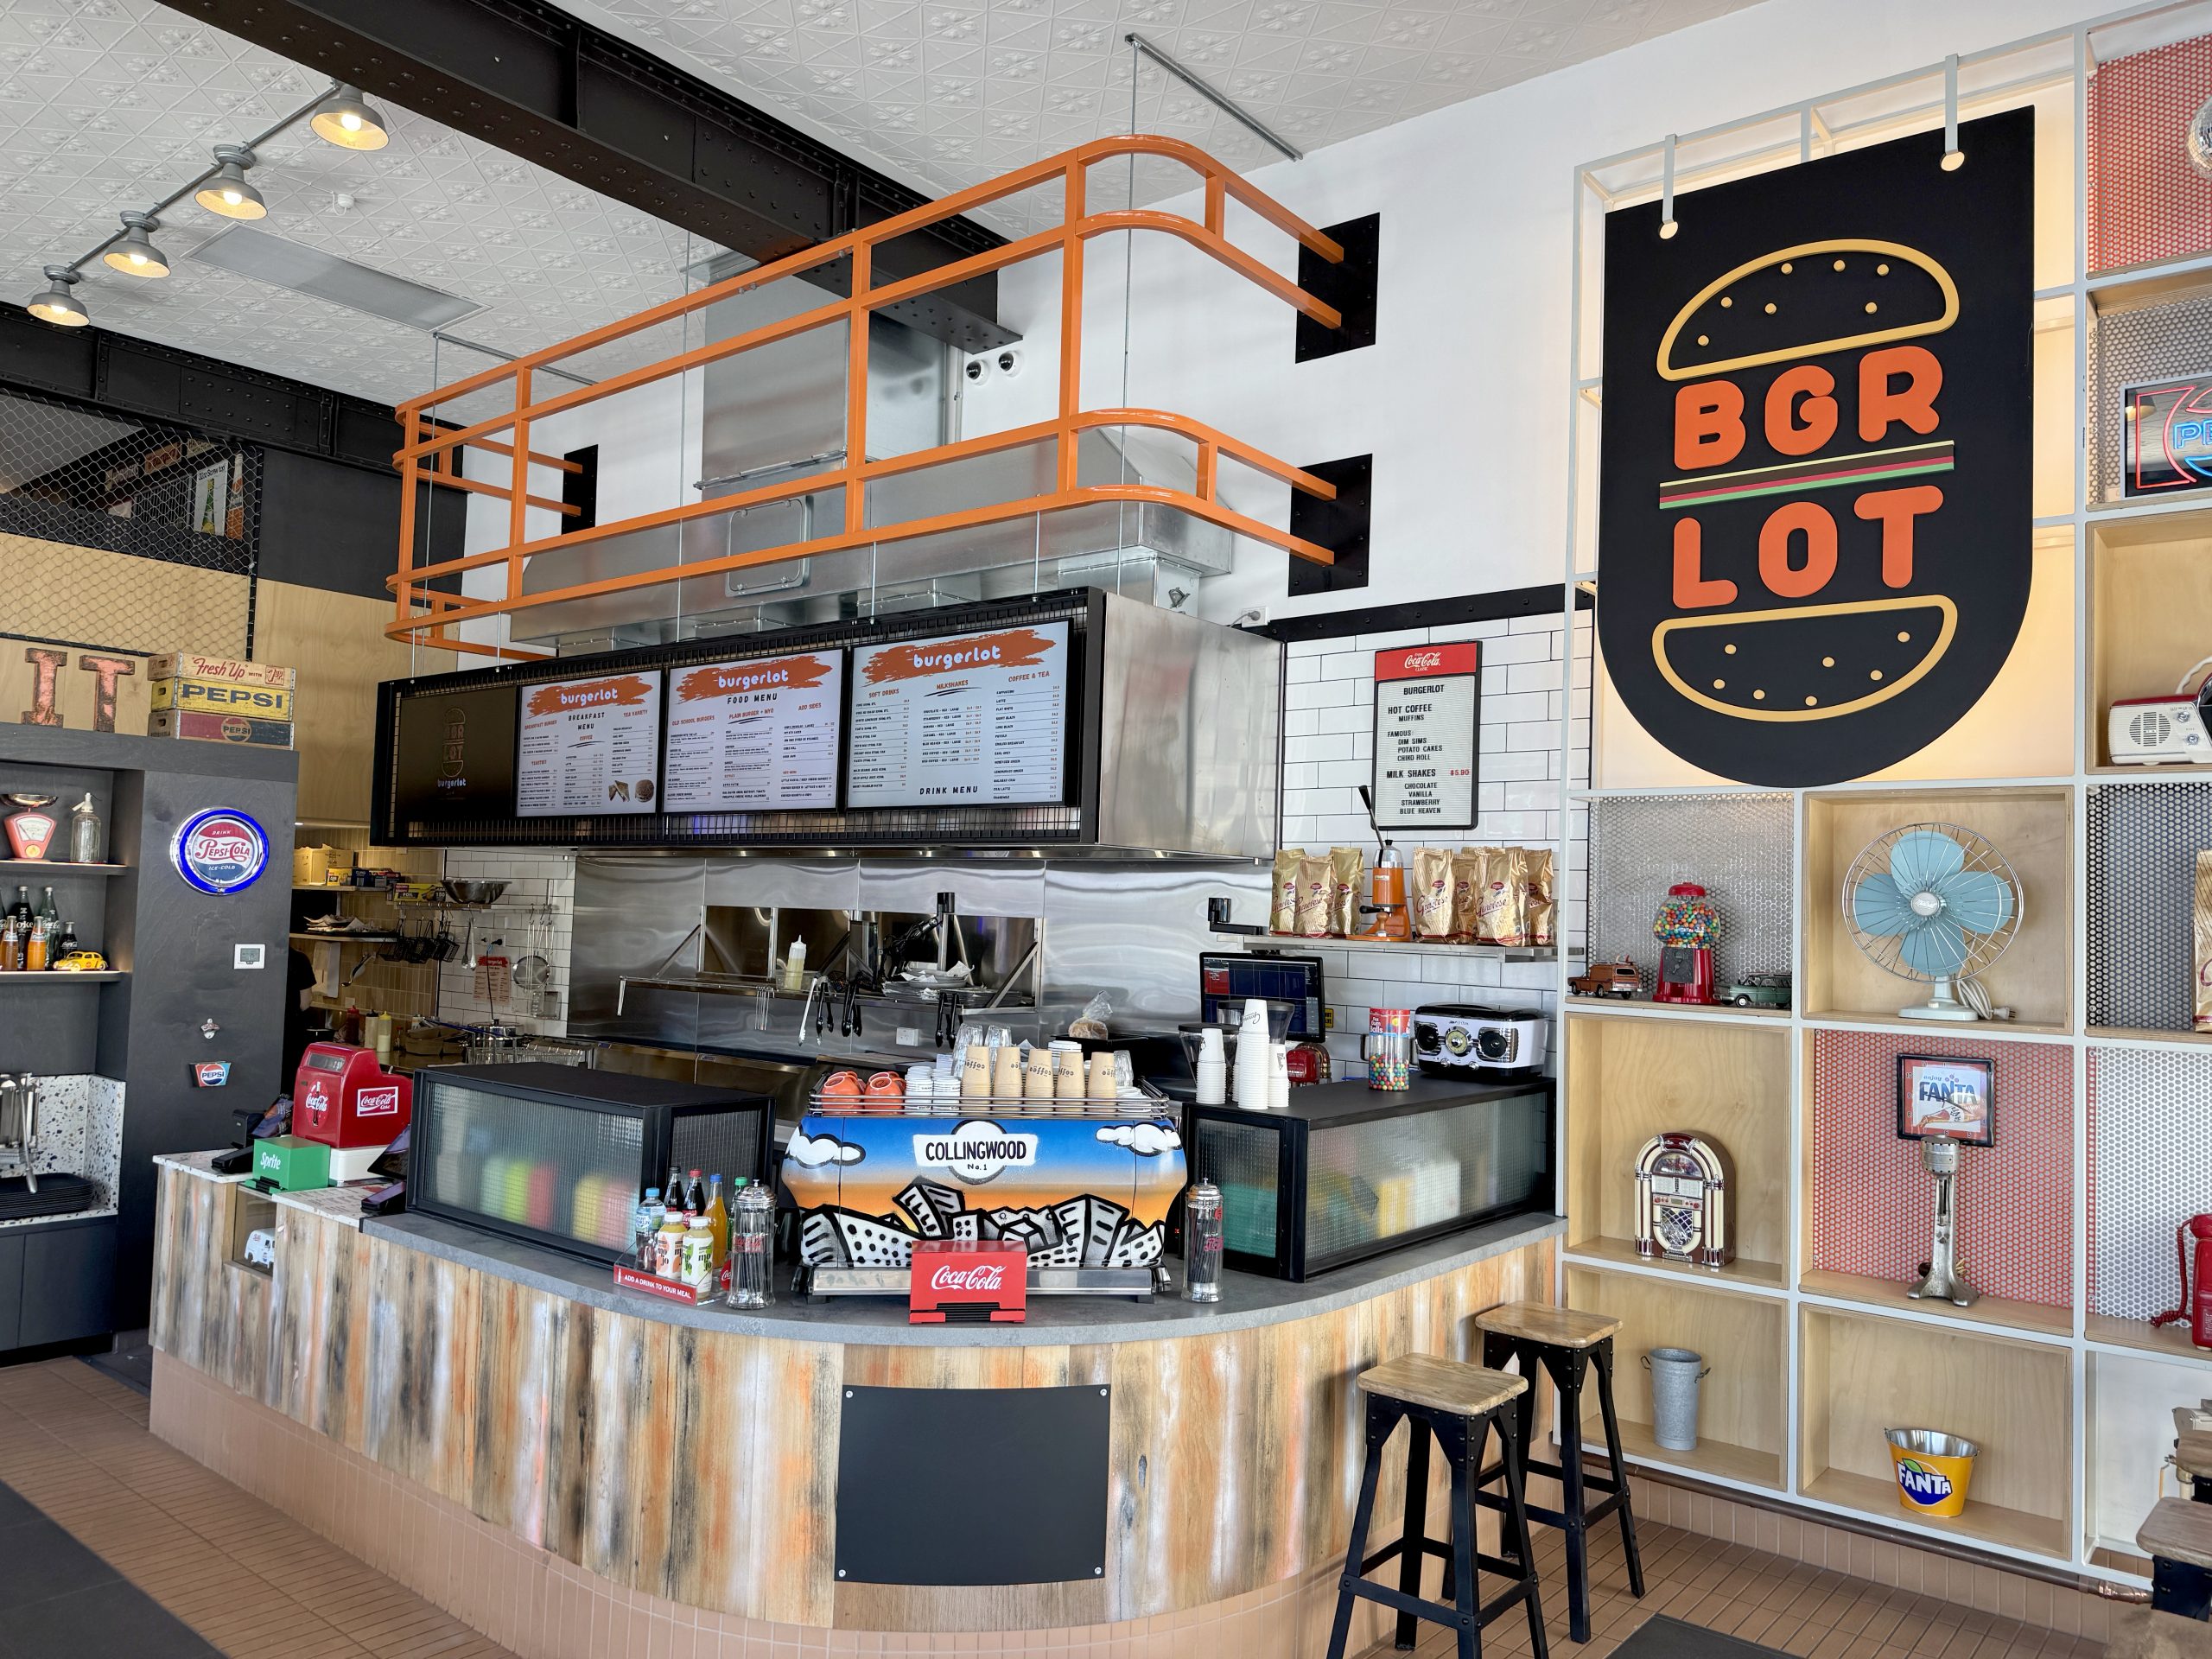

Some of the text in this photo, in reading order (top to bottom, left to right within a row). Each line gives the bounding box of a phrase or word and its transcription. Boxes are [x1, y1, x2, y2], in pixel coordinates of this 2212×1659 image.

[1673, 346, 1944, 471] BGR
[1672, 485, 1944, 609] LOT
[913, 645, 1001, 670] burgerlot
[1404, 652, 1441, 668] Coca-Cola
[718, 670, 789, 690] burgerlot
[937, 680, 969, 690] MILKSHAKES
[182, 683, 282, 709] PEPSI
[561, 688, 618, 706] burgerlot
[728, 693, 778, 704] FOOD MENU
[1403, 684, 1444, 696] BURGERLOT
[568, 712, 605, 721] BREAKFAST
[1405, 704, 1433, 713] COFFEE
[223, 726, 251, 734] PEPSI
[1387, 770, 1403, 779] MILK
[361, 1093, 395, 1106] Coca-Cola
[1919, 1080, 1978, 1105] FANTA
[925, 1141, 1027, 1161] COLLINGWOOD
[260, 1152, 281, 1170] Sprite
[624, 1274, 635, 1283] ADD
[639, 1280, 655, 1288] DRINK
[663, 1285, 677, 1294] YOUR
[677, 1289, 691, 1299] MEAL
[931, 1265, 1007, 1291] Coca-Cola
[1897, 1462, 1952, 1495] FANTA
